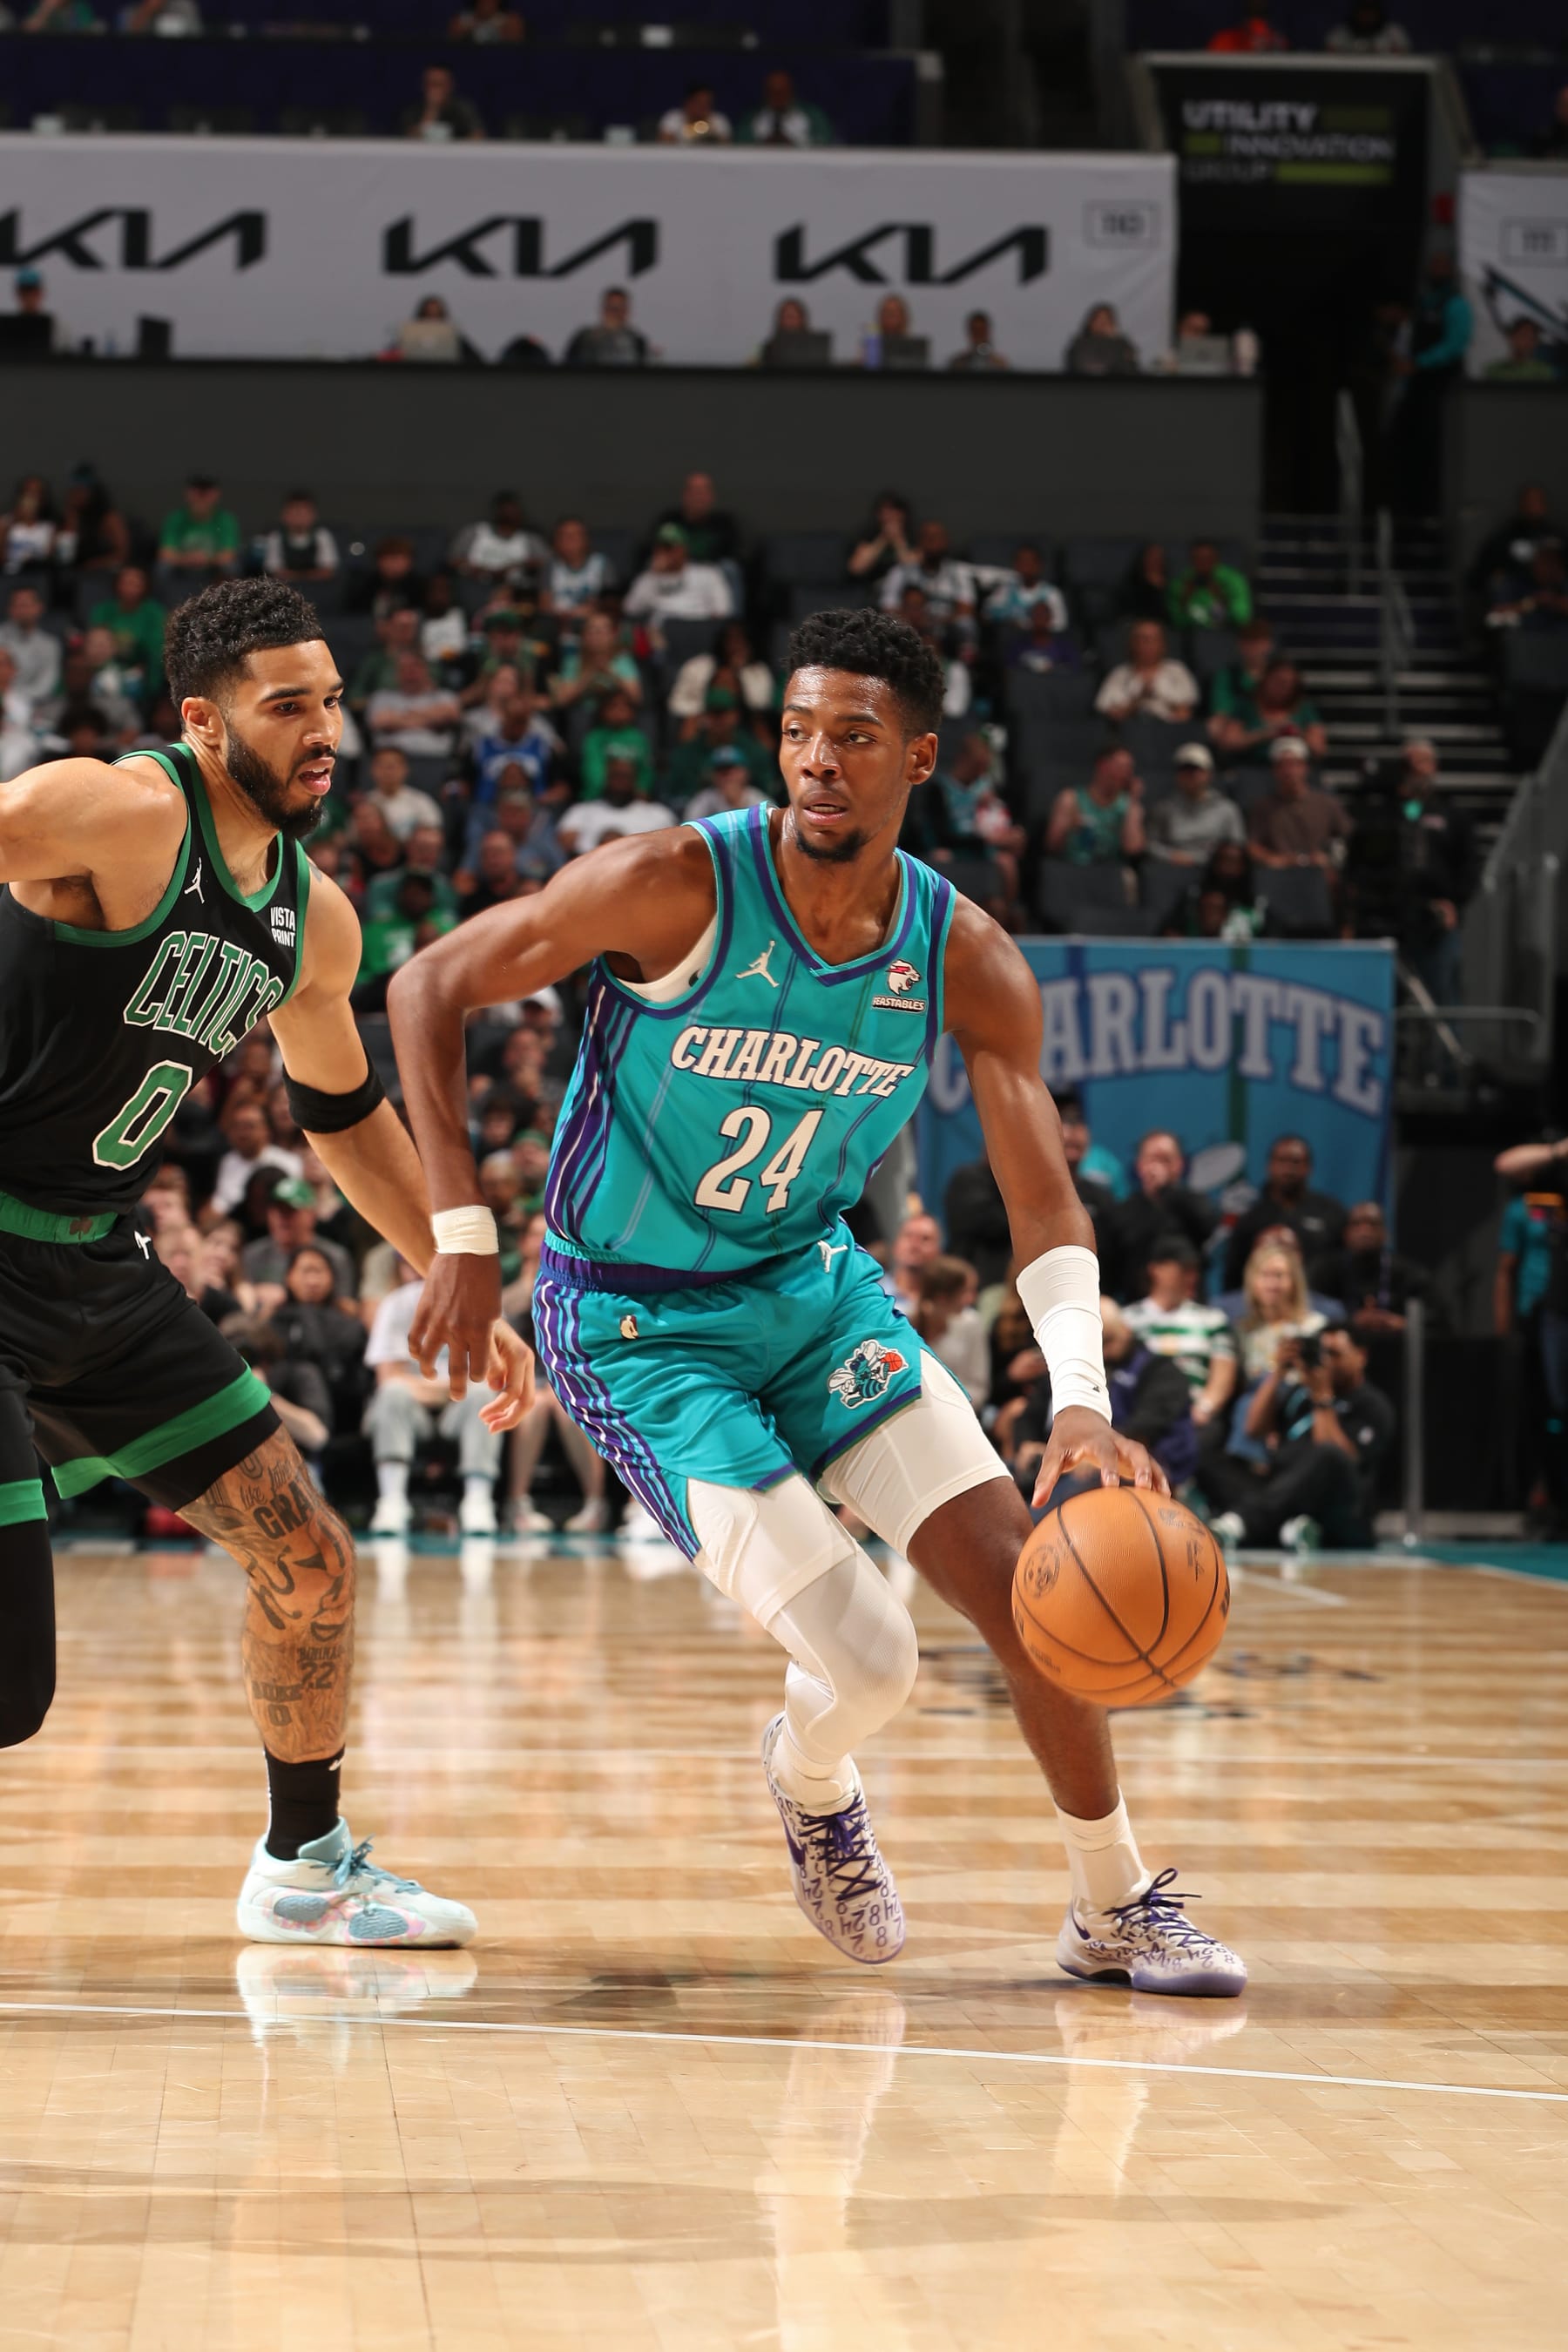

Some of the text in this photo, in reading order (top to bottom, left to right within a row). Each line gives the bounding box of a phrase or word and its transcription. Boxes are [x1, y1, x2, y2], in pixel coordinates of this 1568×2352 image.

[1181, 99, 1319, 130] UTILITY
[382, 214, 659, 279] KIA
[774, 222, 1051, 287] KIA
[270, 906, 295, 932] VISTA
[271, 928, 295, 948] PRINT
[872, 996, 925, 1011] FEASTABLES
[670, 1024, 916, 1098] CHARLOTTE
[92, 1059, 193, 1172] 0
[693, 1104, 826, 1214] 24
